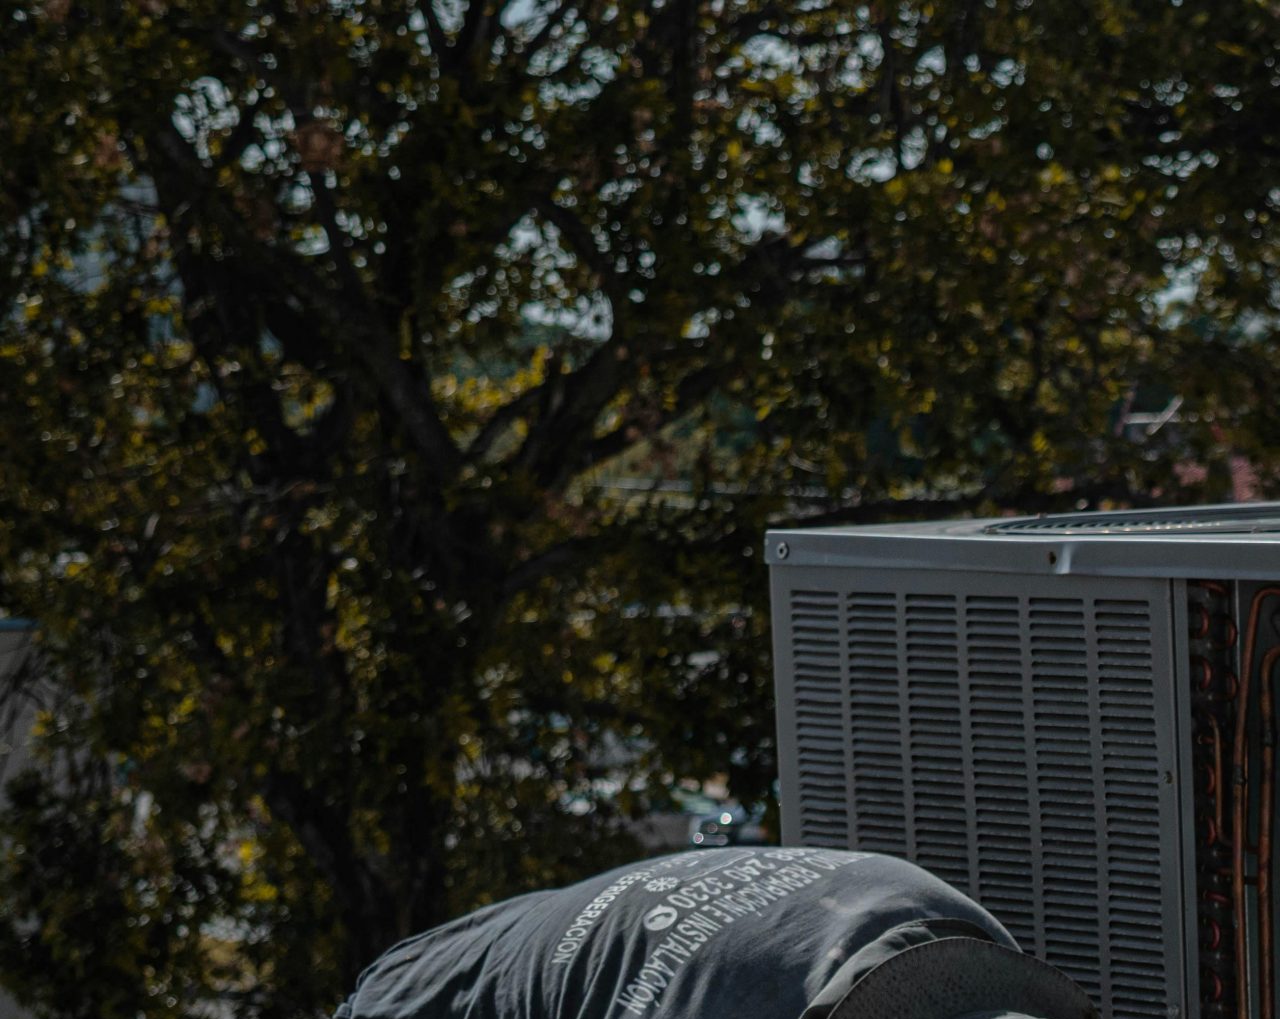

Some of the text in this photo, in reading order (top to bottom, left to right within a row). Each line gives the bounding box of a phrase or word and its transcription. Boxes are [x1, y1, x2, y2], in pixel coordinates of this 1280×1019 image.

[723, 858, 776, 882] 240
[667, 877, 734, 909] 3230
[713, 863, 822, 917] REPARACIÓN
[702, 904, 734, 923] E
[616, 911, 724, 1016] INSTALACIÓN
